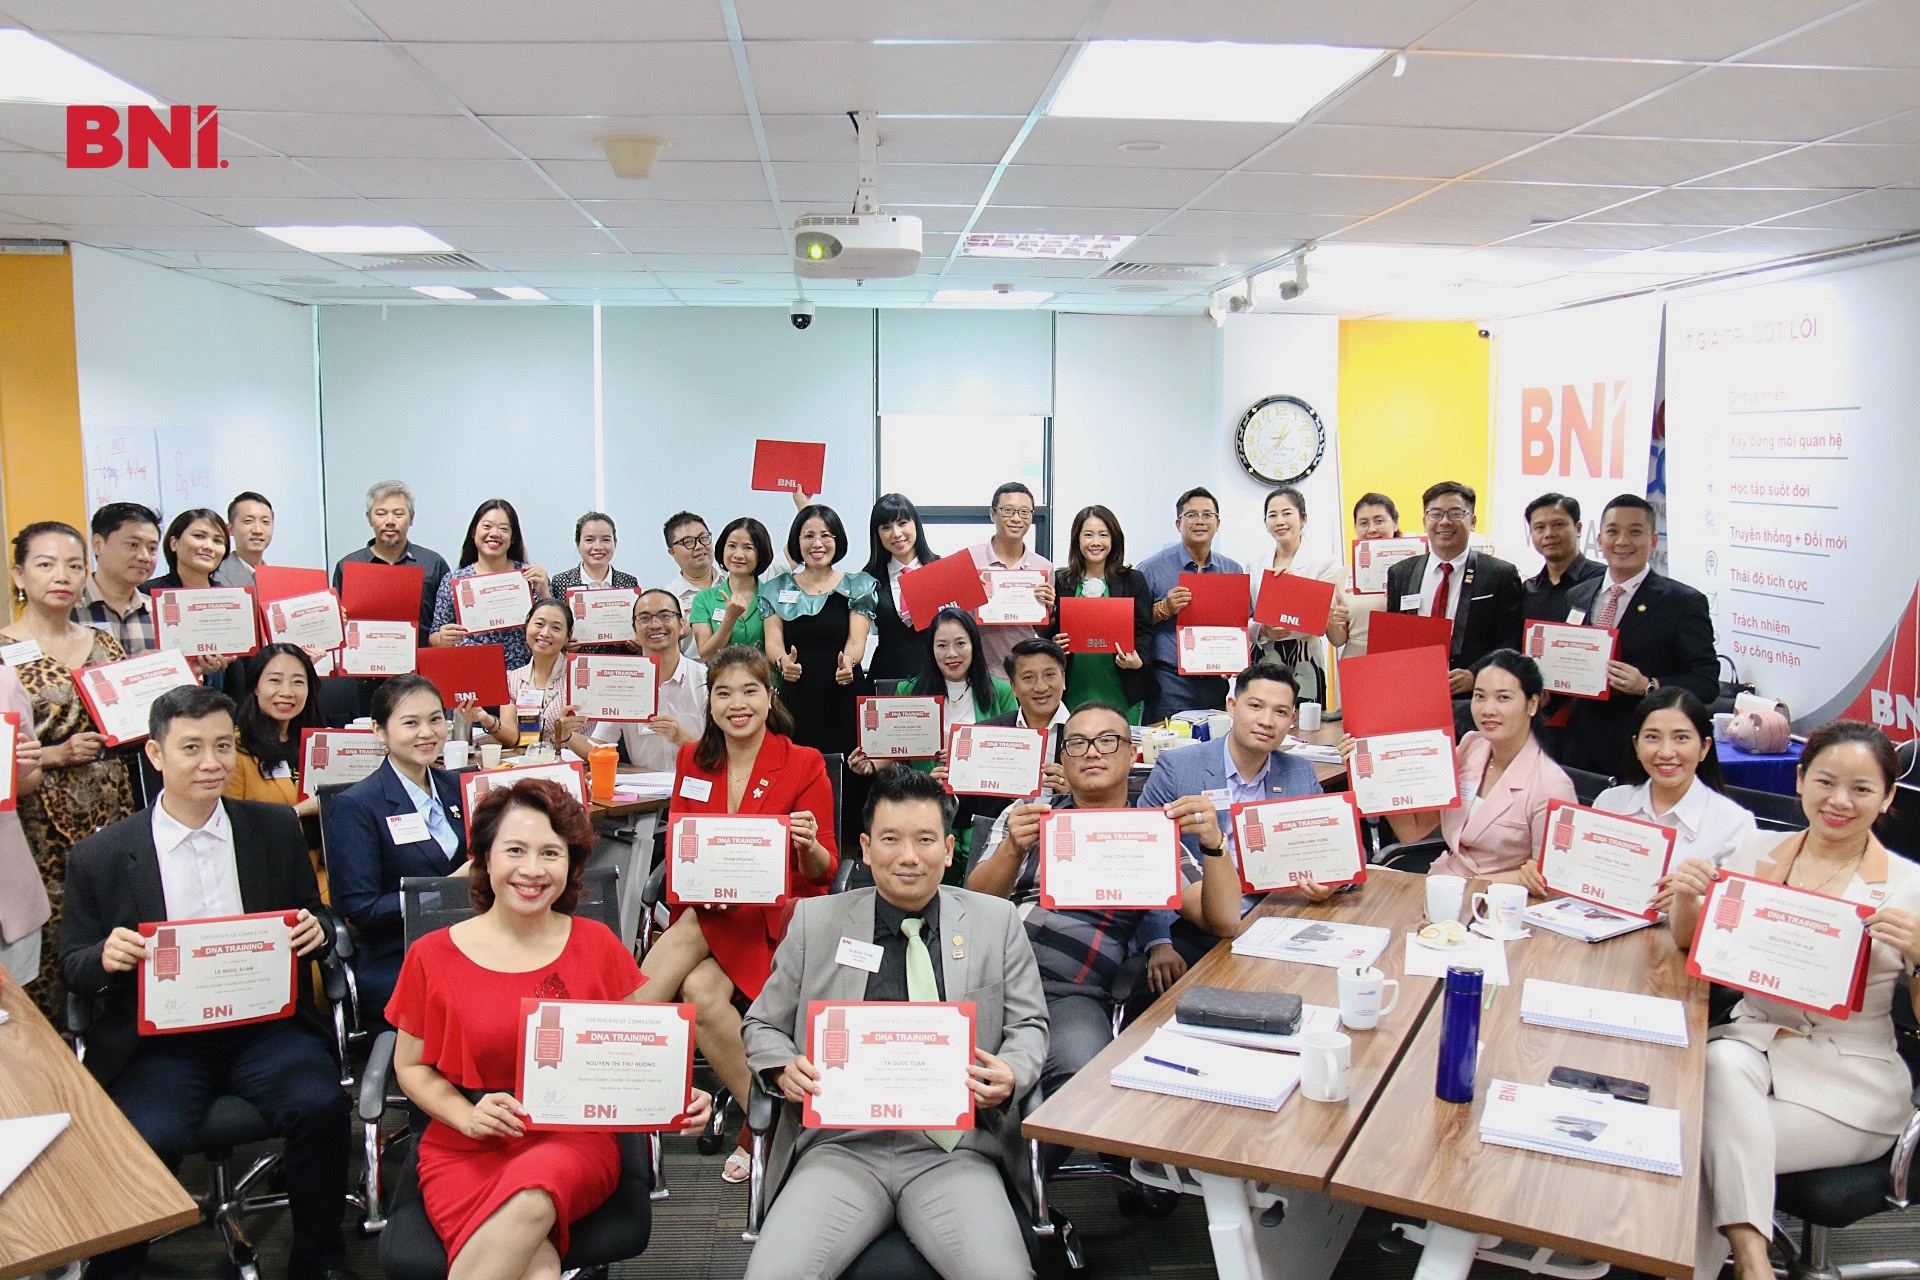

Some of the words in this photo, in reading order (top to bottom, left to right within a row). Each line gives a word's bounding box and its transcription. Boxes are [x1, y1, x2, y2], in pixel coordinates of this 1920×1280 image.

[1800, 436, 1825, 449] quan
[1830, 433, 1842, 450] hệ
[1731, 568, 1750, 582] Thái
[1732, 613, 1758, 628] Trách
[1761, 619, 1790, 635] nhiệm
[1750, 645, 1773, 663] công
[1298, 818, 1329, 827] TRAINING
[1767, 911, 1785, 921] DNA
[1787, 915, 1829, 932] TRAINING
[206, 946, 223, 955] DNA
[225, 943, 263, 953] TRAINING
[591, 1033, 609, 1041] DNA
[612, 1034, 654, 1042] TRAINING
[875, 1033, 893, 1041] DNA
[895, 1034, 937, 1042] TRAINING
